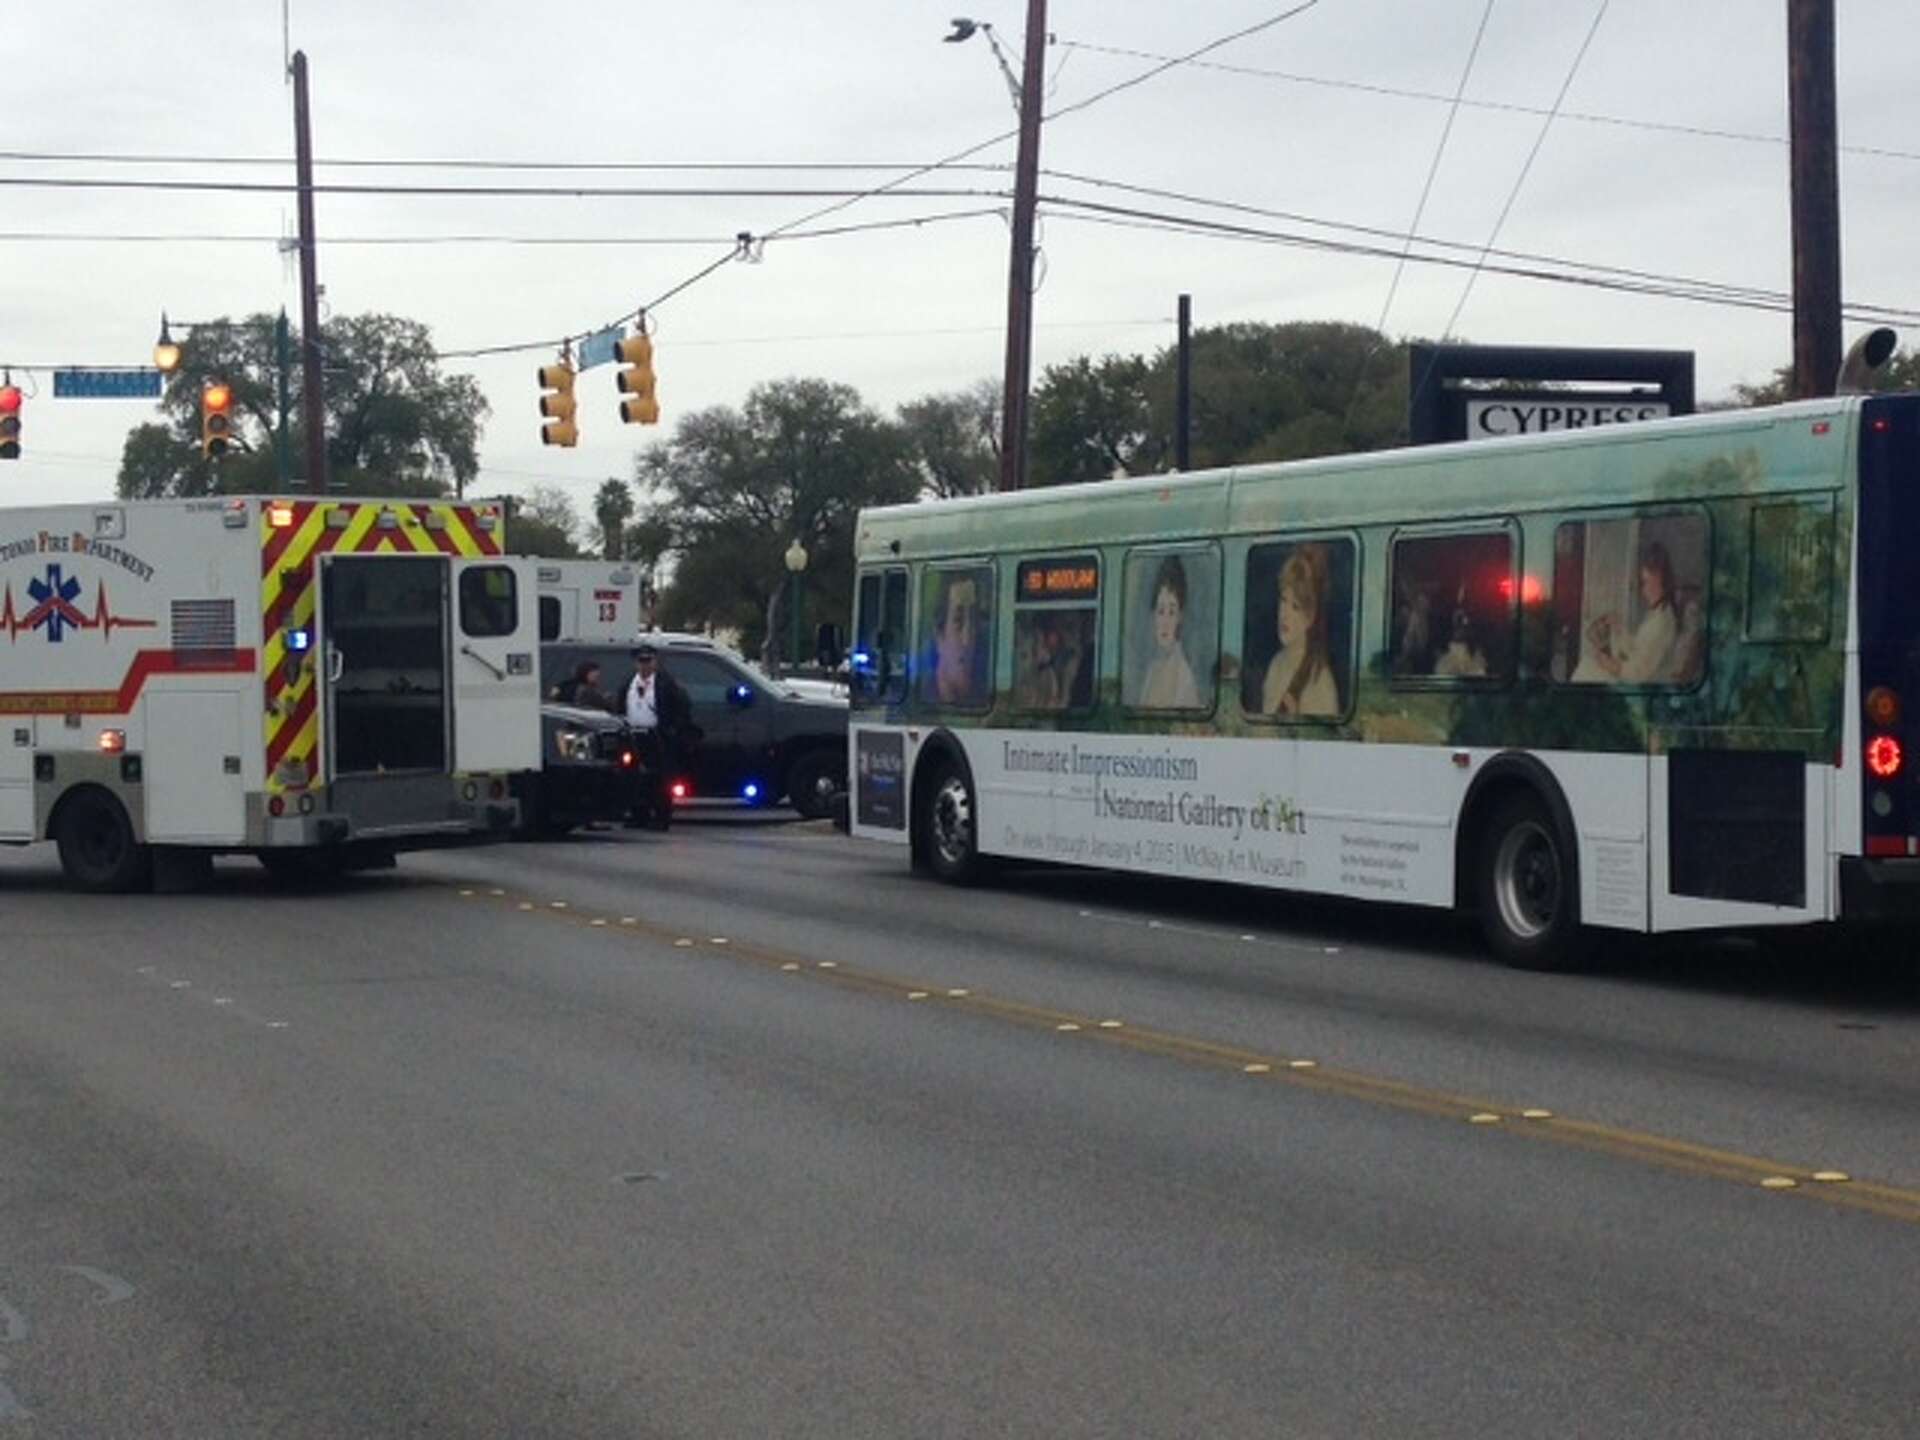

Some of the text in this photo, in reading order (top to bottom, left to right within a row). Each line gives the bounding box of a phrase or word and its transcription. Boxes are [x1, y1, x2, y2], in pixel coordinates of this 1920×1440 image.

[1478, 405, 1657, 434] CYPRESS
[599, 603, 616, 621] 13
[1004, 741, 1198, 781] Intimate Impressionism
[1103, 788, 1306, 841] National Gallery of Art
[1089, 833, 1132, 864] January
[1247, 849, 1306, 879] Museum
